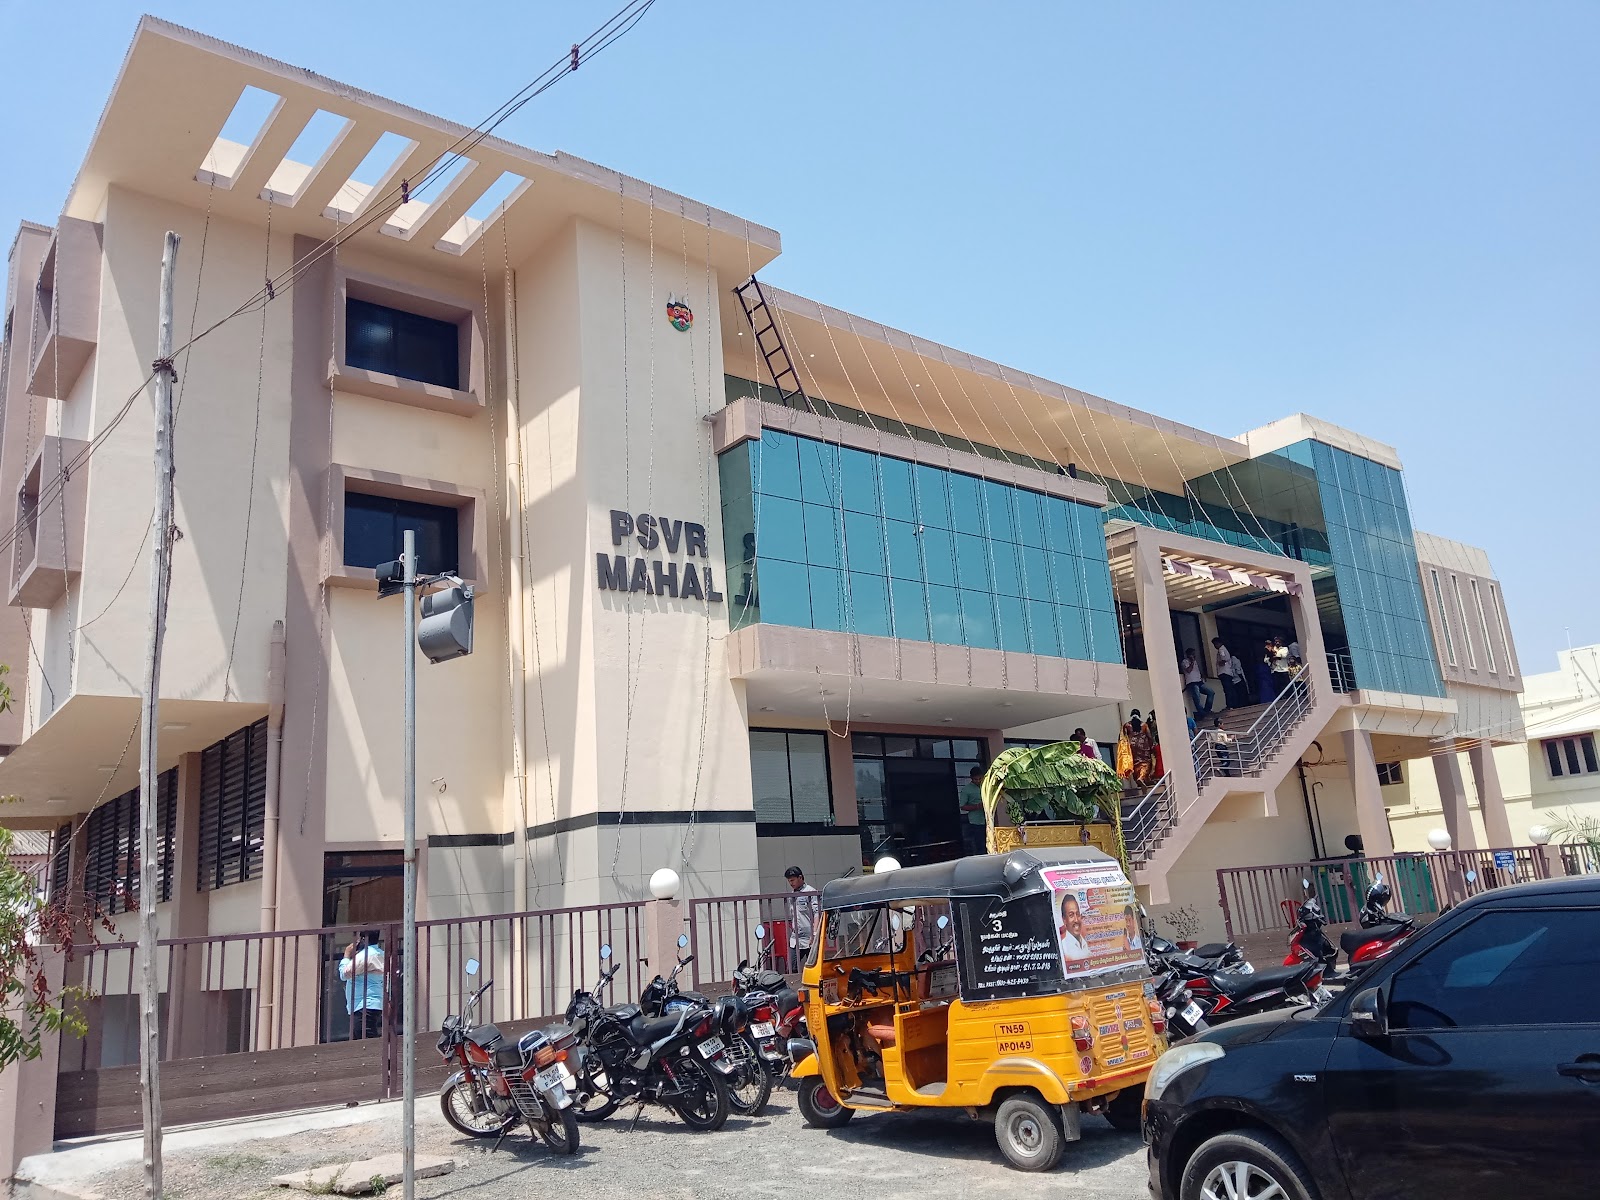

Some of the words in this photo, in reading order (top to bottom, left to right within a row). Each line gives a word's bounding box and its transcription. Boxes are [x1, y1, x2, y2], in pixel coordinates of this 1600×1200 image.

[609, 509, 707, 558] PSVR
[596, 552, 723, 602] MAHAL
[992, 919, 1003, 932] 3
[999, 1024, 1025, 1034] TN59
[999, 1041, 1032, 1052] AP0149
[541, 1072, 551, 1081] TN
